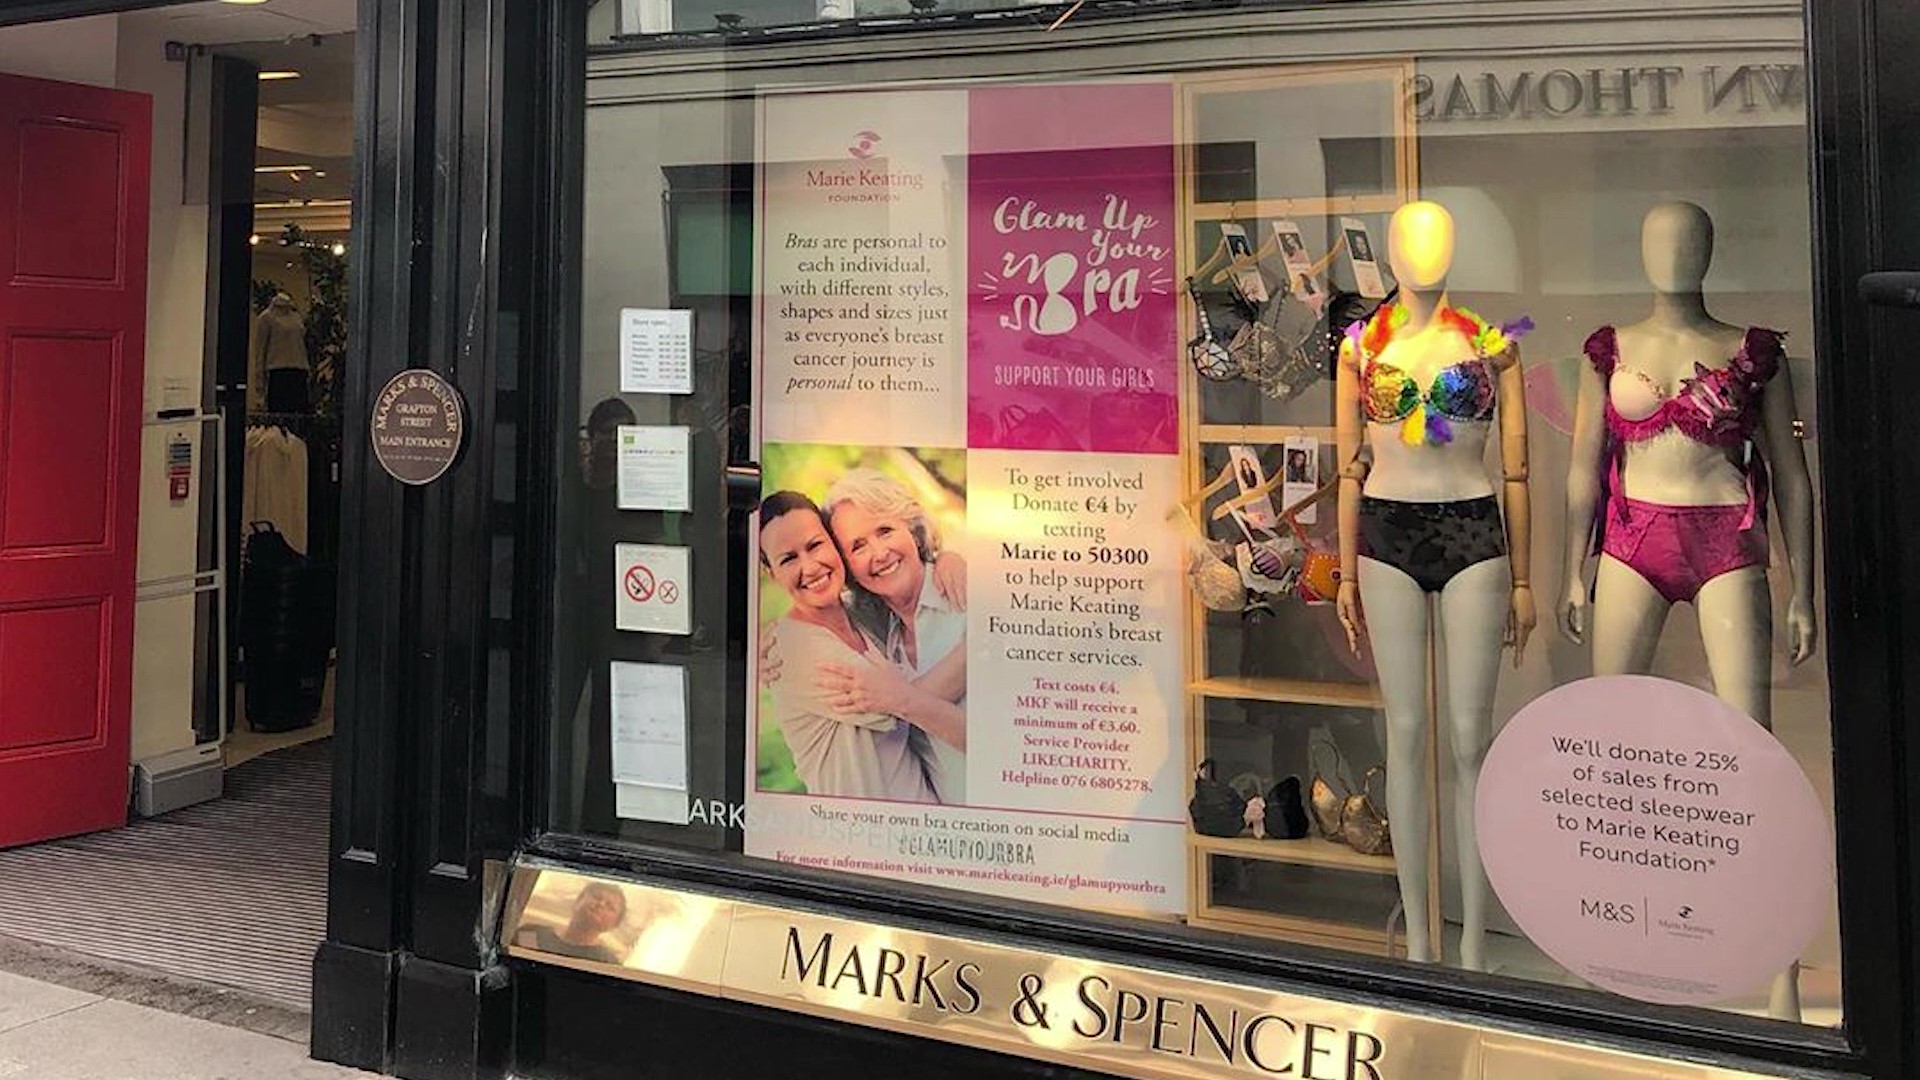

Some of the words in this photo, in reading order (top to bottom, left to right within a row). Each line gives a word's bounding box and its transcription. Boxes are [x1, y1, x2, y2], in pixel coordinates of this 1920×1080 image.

[808, 170, 855, 186] Marie
[859, 170, 923, 189] Keating
[828, 194, 900, 203] FOUNDATION
[994, 196, 1088, 234] Glam
[1103, 193, 1158, 240] Up
[785, 233, 819, 249] Bras
[823, 236, 847, 249] are
[853, 233, 923, 254] personal
[929, 236, 946, 249] to
[1087, 229, 1170, 266] Your
[798, 257, 834, 272] each
[840, 256, 931, 274] individual,
[780, 280, 817, 296] with
[822, 280, 893, 297] different
[898, 281, 949, 301] styles,
[781, 303, 833, 323] shapes
[838, 304, 870, 320] and
[875, 305, 912, 320] sizes
[917, 305, 948, 324] just
[785, 331, 800, 343] as
[805, 326, 889, 347] everyone's
[895, 327, 944, 344] breast
[794, 355, 846, 367] cancer
[851, 351, 917, 372] journey
[922, 353, 934, 367] is
[786, 375, 853, 393] personal
[858, 378, 874, 391] to
[880, 375, 940, 392] them...
[995, 365, 1059, 385] SUPPORT
[1066, 367, 1106, 386] YOUR
[1112, 368, 1155, 387] GIRLS
[376, 381, 407, 430] MARKS
[408, 376, 418, 388] &
[420, 377, 457, 432] SPENCER
[396, 404, 437, 414] GRAFTON
[400, 417, 433, 427] STREET
[380, 436, 404, 446] MAIN
[405, 437, 451, 448] ENTRANCE
[1004, 468, 1029, 485] To
[1034, 475, 1060, 490] get
[1068, 472, 1144, 490] involved
[1012, 494, 1079, 513] Donate
[1085, 496, 1109, 513] €4
[1115, 499, 1137, 519] by
[1043, 523, 1106, 543] texting
[1000, 542, 1057, 561] Marie
[1062, 550, 1081, 561] to
[1088, 546, 1149, 565] 50300
[1005, 572, 1023, 584] to
[1029, 568, 1068, 591] help
[1074, 575, 1145, 594] support
[1010, 593, 1064, 611] Marie
[1069, 596, 1140, 621] Keating
[989, 616, 1103, 639] Foundation's
[1109, 621, 1163, 642] breast
[1006, 647, 1064, 662] cancer
[1069, 648, 1143, 667] services.
[1033, 677, 1060, 691] Text
[1064, 682, 1095, 693] costs
[1100, 682, 1120, 694] €4.
[1016, 696, 1051, 709] MKF
[1054, 699, 1078, 711] will
[1082, 701, 1126, 713] receive
[1014, 715, 1078, 729] minimum
[1082, 719, 1098, 731] of
[1099, 721, 1141, 734] €3.60.
[1024, 734, 1069, 748] Service
[1073, 737, 1130, 751] Provider
[1023, 752, 1132, 772] LIKECHARITY.
[1552, 737, 1601, 758] We'll
[1609, 743, 1688, 767] donate
[1695, 752, 1739, 773] 25%
[1002, 770, 1059, 787] Helpline
[1061, 774, 1086, 787] 076
[1573, 765, 1596, 782] of
[1602, 769, 1657, 789] sales
[1664, 773, 1719, 796] from
[1541, 788, 1634, 812] selected
[1640, 799, 1755, 826] sleepwear
[810, 805, 848, 821] Share
[853, 811, 884, 827] your
[888, 815, 919, 827] own
[924, 813, 947, 829] bra
[952, 818, 1009, 835] creation
[1015, 823, 1034, 836] on
[1038, 823, 1079, 839] social
[1084, 828, 1130, 844] media
[1556, 814, 1579, 830] to
[1586, 817, 1646, 839] Marie
[1653, 825, 1740, 855] Keating
[776, 851, 796, 863] For
[799, 855, 829, 865] more
[833, 855, 904, 872] information
[907, 863, 933, 874] visit
[936, 865, 1166, 894] www.mariekeating.ie/glamupyourbra
[1580, 899, 1635, 924] M&S
[781, 926, 984, 1016] MARKS
[1010, 972, 1052, 1030] &
[1071, 975, 1386, 1080] SPENCER
